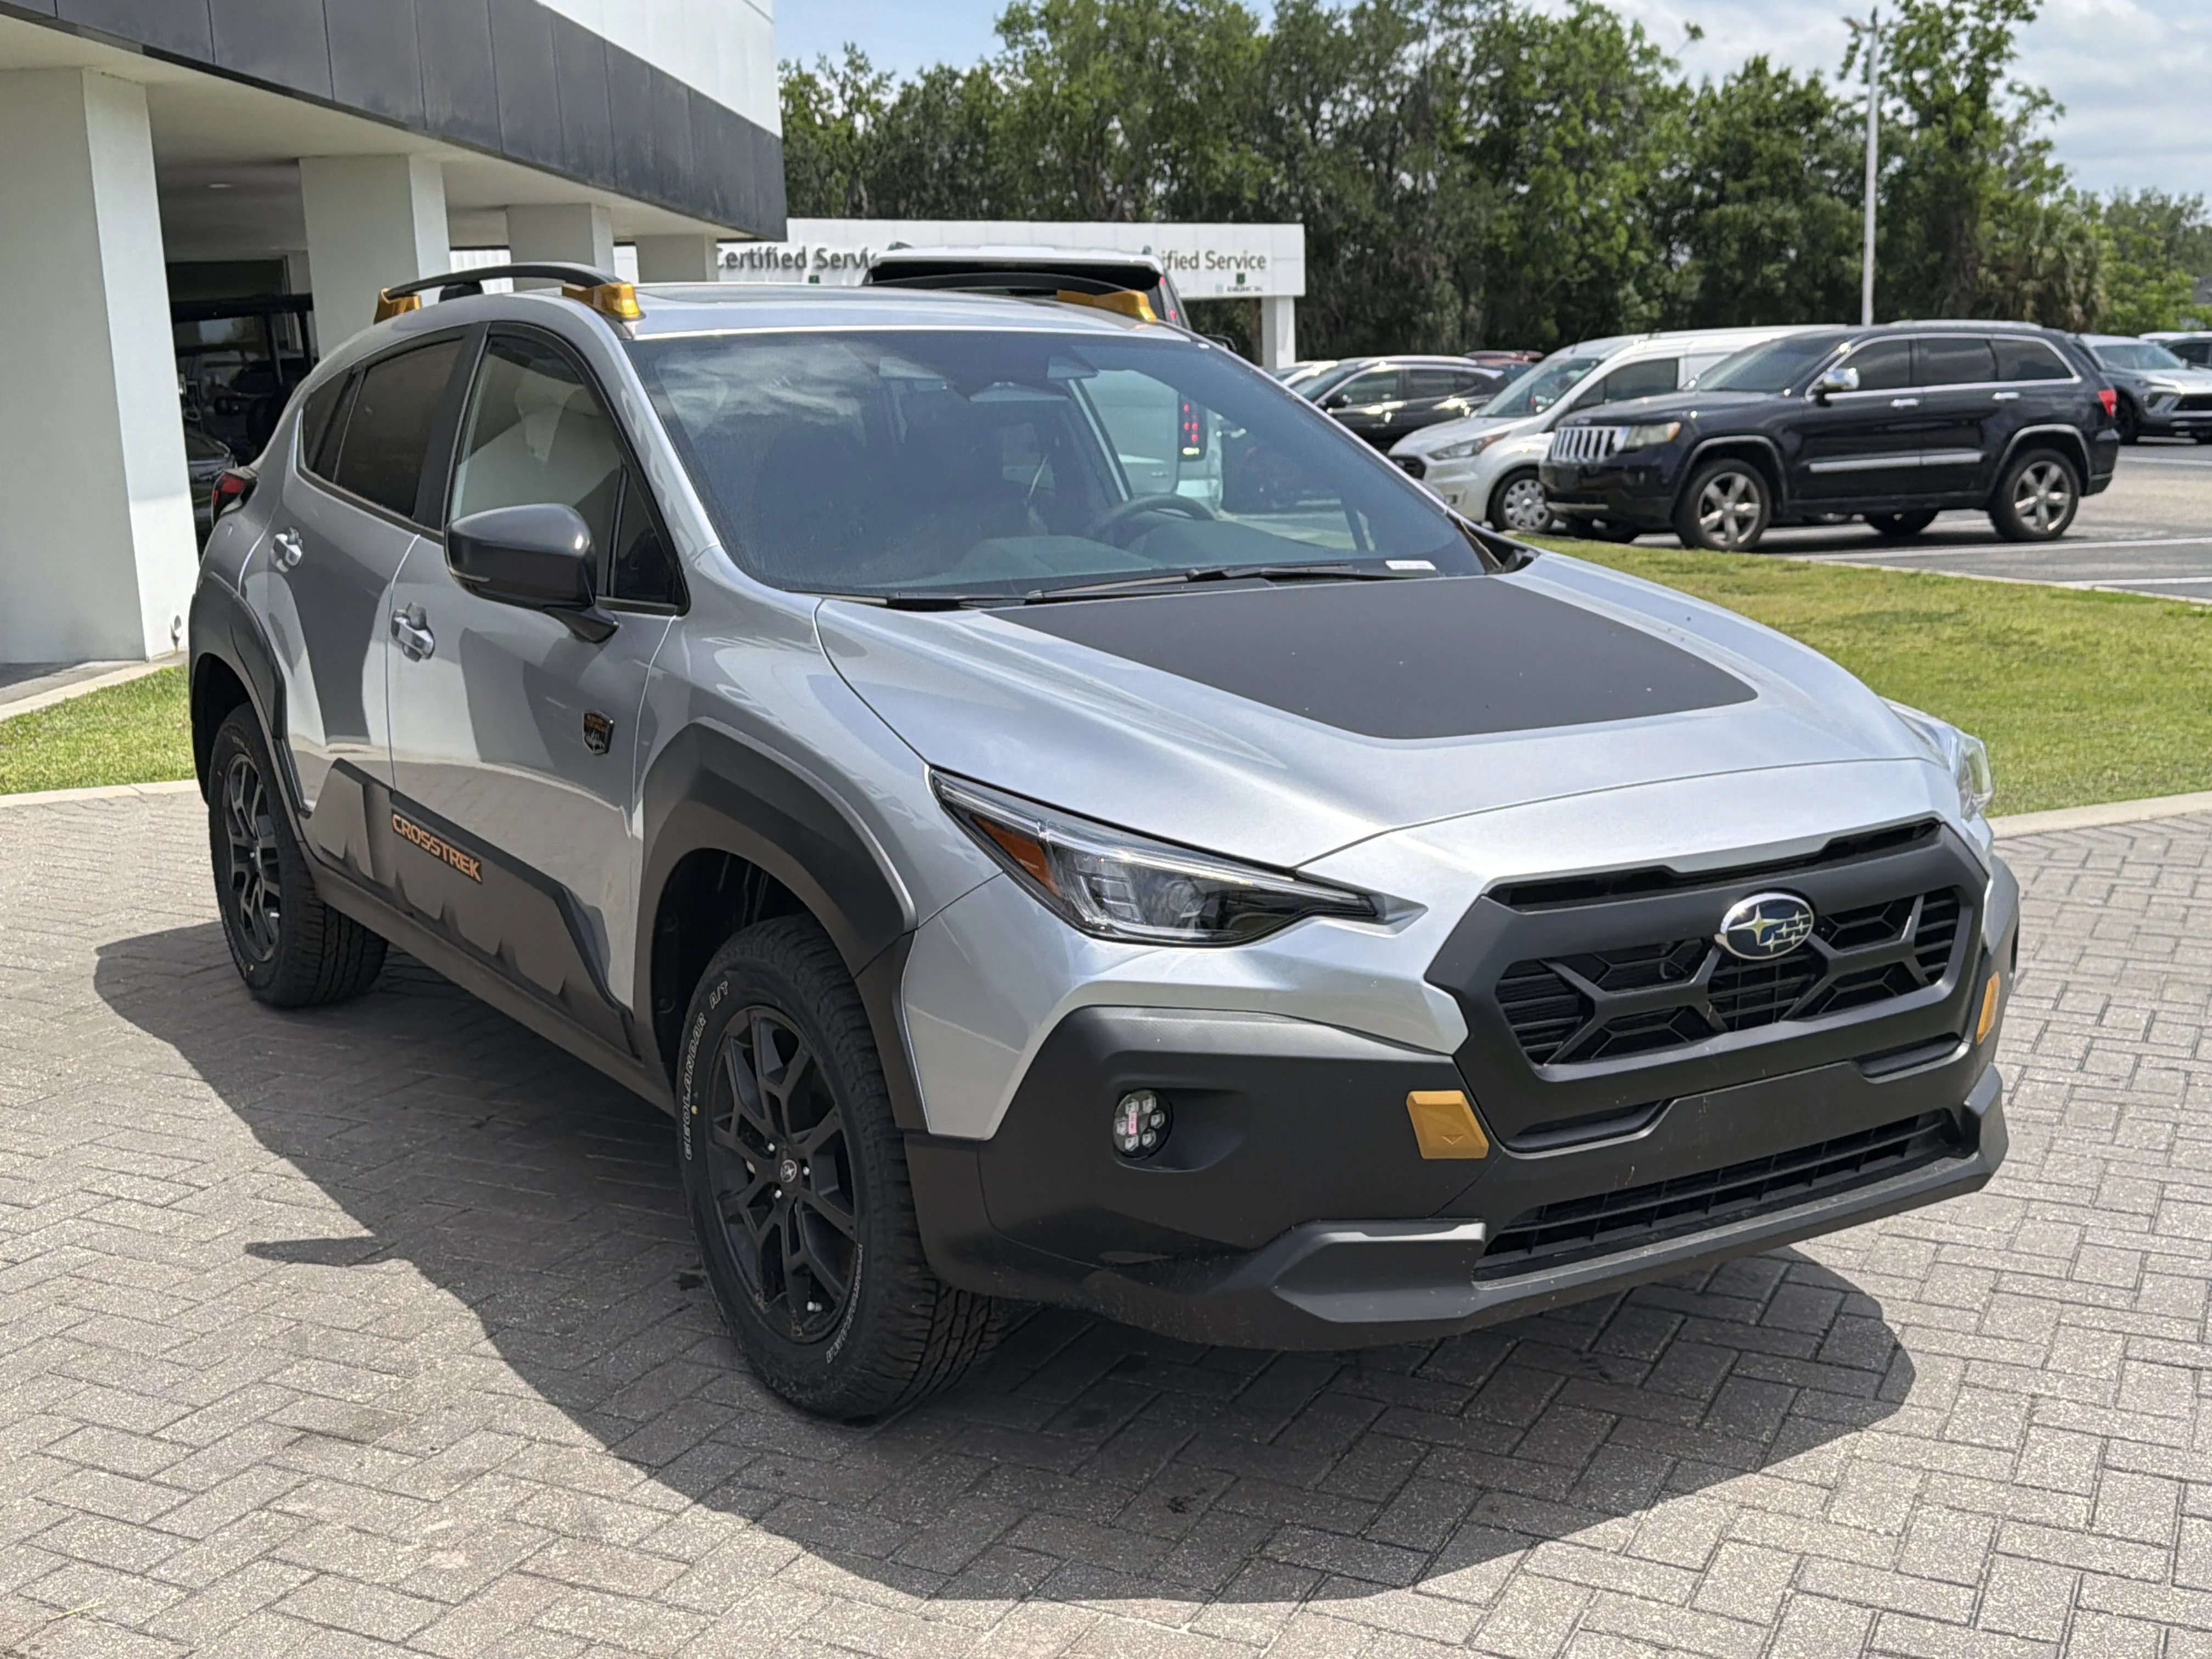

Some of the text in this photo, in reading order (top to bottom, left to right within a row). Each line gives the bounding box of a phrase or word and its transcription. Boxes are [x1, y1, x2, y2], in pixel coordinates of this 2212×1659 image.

[814, 246, 877, 269] Servi
[1161, 250, 1266, 270] ified Service
[392, 814, 482, 882] CROSSTREK
[682, 981, 728, 1160] GEOLANDAR A/T
